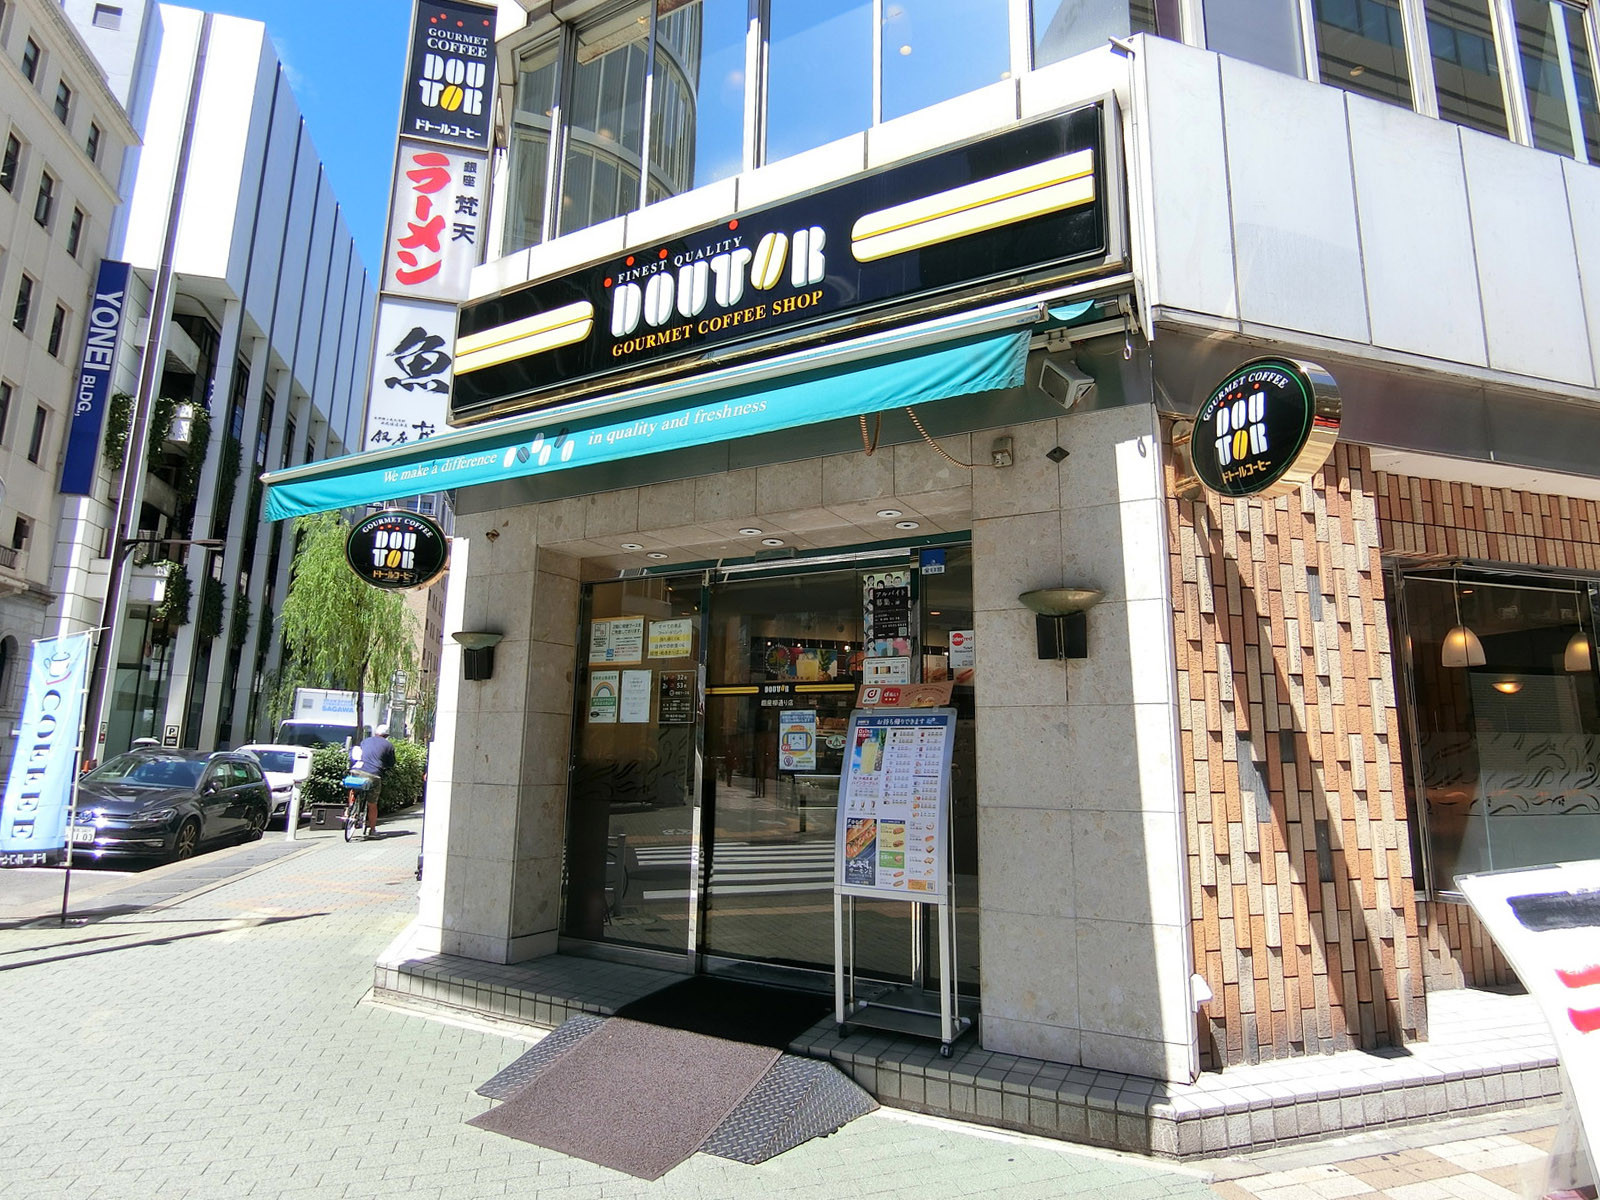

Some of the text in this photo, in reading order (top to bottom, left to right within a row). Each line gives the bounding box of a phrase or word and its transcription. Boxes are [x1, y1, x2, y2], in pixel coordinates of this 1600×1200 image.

[427, 38, 487, 58] COFFEE
[428, 28, 488, 46] GOURMET
[415, 118, 481, 139] ドトールコーヒー
[395, 152, 452, 285] ラーメン
[451, 161, 479, 244] 銀座 梵天
[611, 225, 826, 338] DOUTOR
[618, 236, 743, 284] FINEST QUALITY
[84, 290, 124, 371] YONEI
[612, 290, 823, 357] GOURMET COFFEE SHOP
[384, 326, 452, 394] 魚
[1202, 370, 1289, 422] GOURMET COFFEE
[588, 400, 767, 445] in quality and freshness
[383, 453, 498, 483] We make a difference
[1221, 459, 1271, 485] ドトールコーヒー
[362, 517, 434, 538] GOURMET COFFEE
[373, 570, 413, 580] ドトールコーヒー
[169, 727, 175, 735] P
